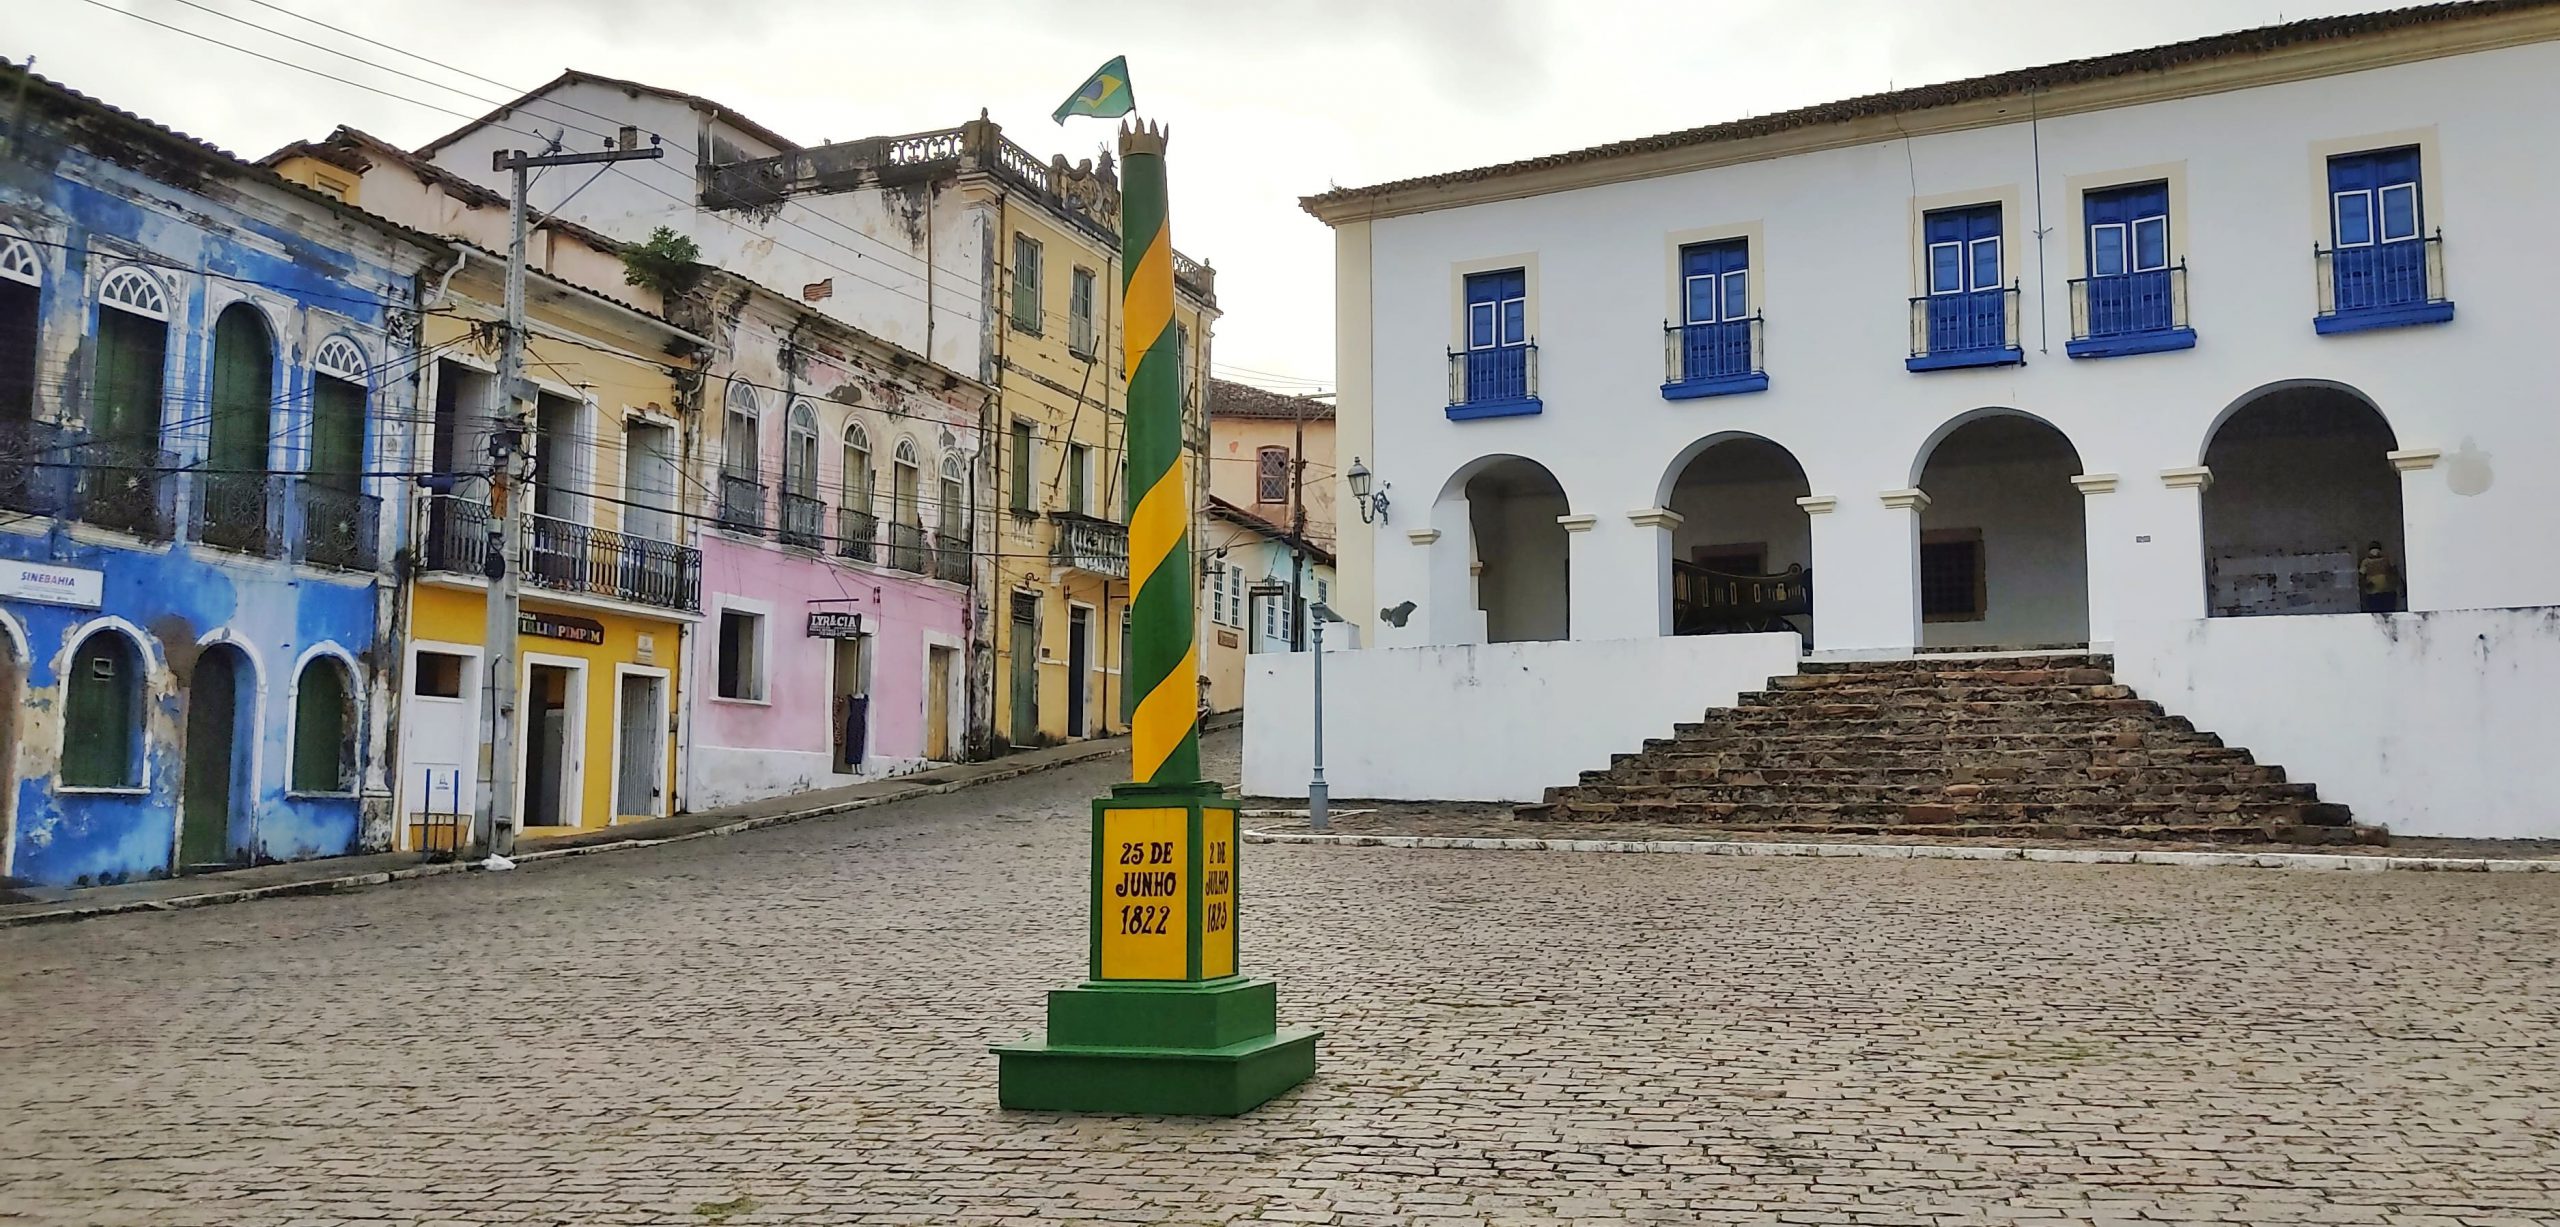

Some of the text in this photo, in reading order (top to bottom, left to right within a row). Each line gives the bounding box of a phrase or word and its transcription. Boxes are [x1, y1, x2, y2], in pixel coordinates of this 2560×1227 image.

[21, 571, 75, 587] SINEBAHIA
[517, 611, 537, 621] SCOLA
[811, 615, 857, 628] LYR&CIA
[518, 620, 601, 643] IRLIMPIMPIM
[1119, 842, 1174, 865] 25 DE
[1209, 841, 1226, 864] 2 DE
[1115, 872, 1177, 897] JUNHO
[1205, 870, 1229, 896] JULHO
[1120, 905, 1171, 935] 1822
[1207, 901, 1228, 933] 1823
